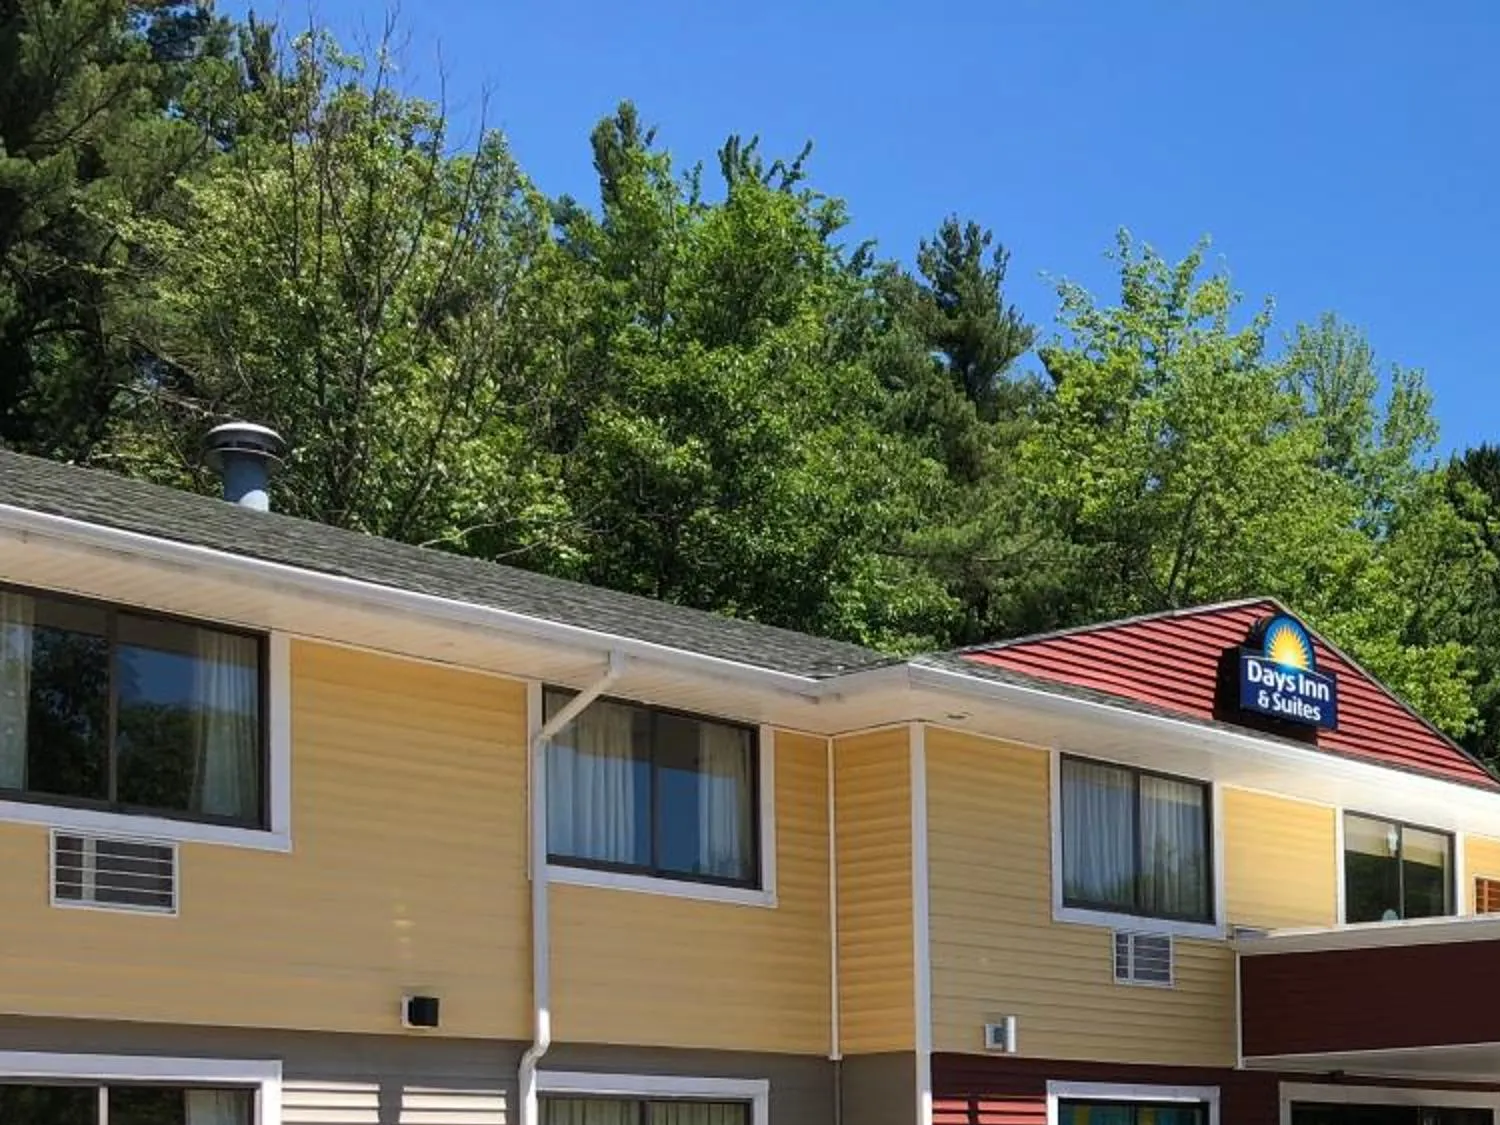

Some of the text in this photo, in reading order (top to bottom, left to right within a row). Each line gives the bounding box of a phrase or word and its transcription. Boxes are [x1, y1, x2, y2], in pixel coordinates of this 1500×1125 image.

[1247, 659, 1329, 701] Days Inn
[1258, 690, 1321, 721] & Suites
